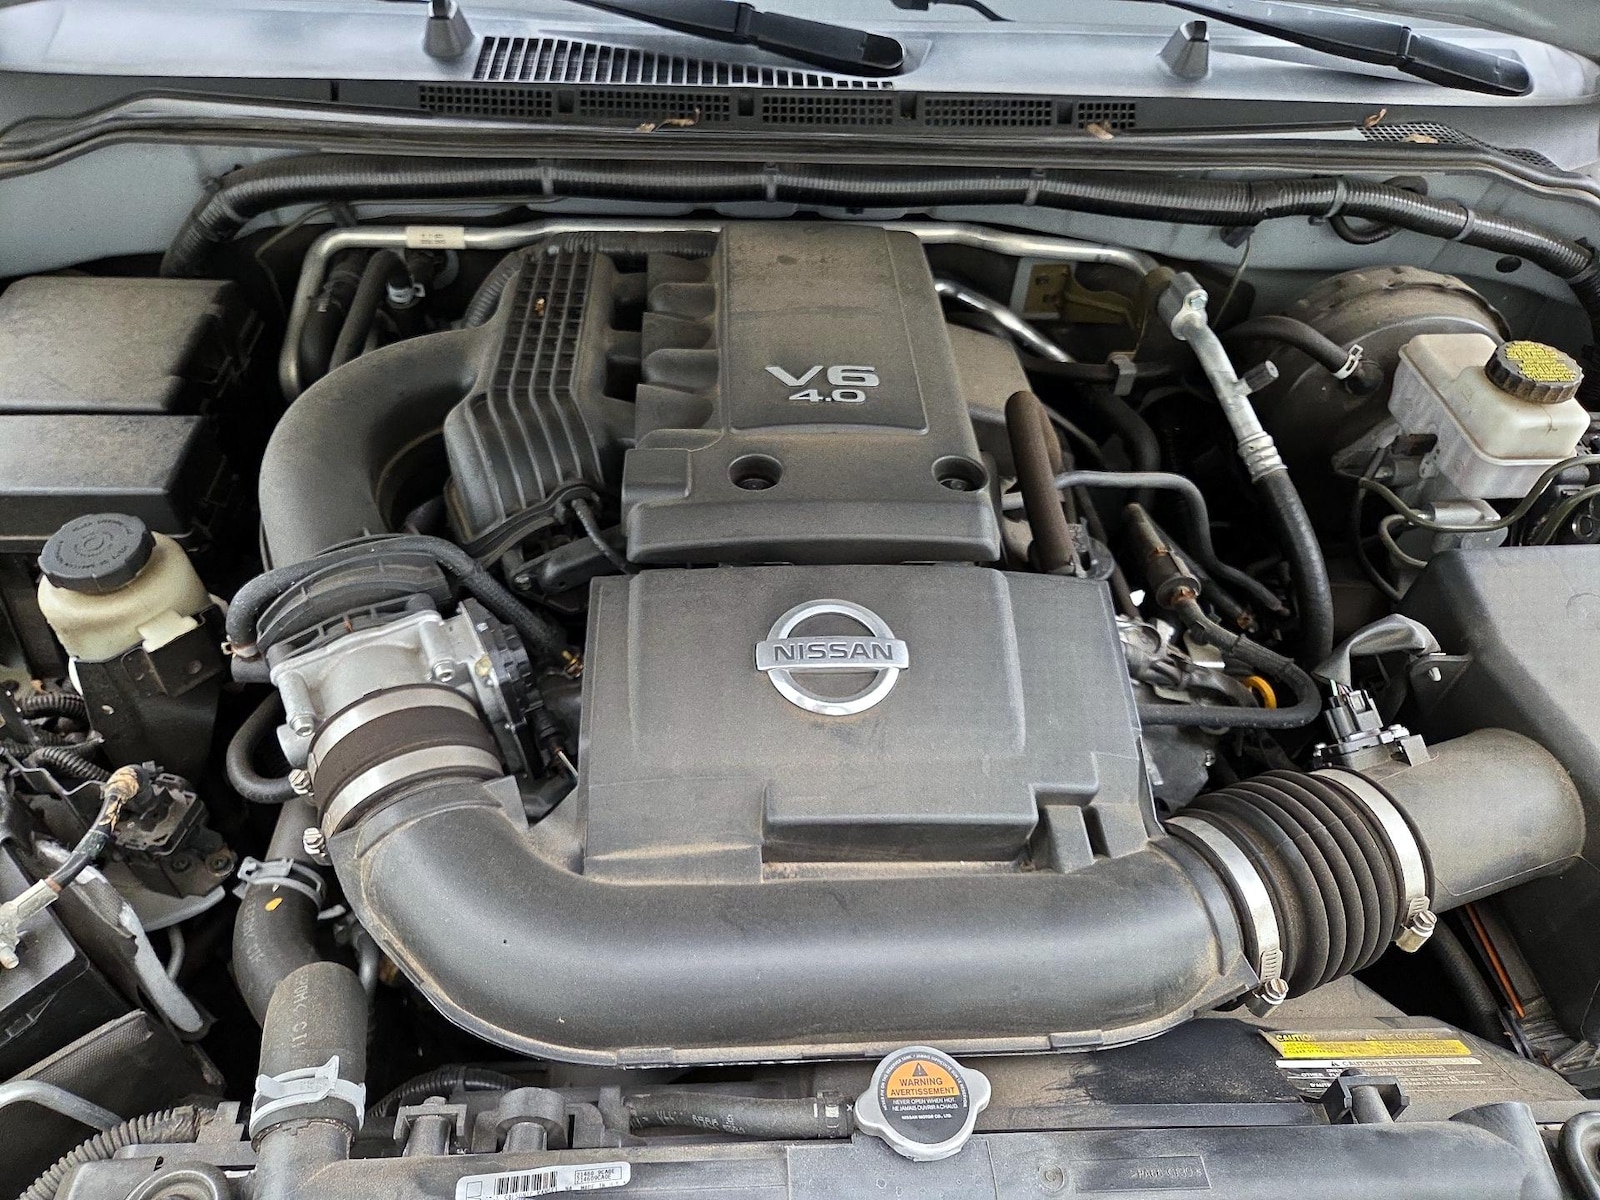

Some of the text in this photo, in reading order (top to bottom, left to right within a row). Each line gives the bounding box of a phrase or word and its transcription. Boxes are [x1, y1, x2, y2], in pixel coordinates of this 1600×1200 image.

[765, 365, 880, 387] V6
[788, 389, 867, 403] 4.0
[774, 643, 894, 661] NISSAN
[899, 1078, 943, 1086] WARNING
[891, 1087, 955, 1096] AVERTISSEMENT
